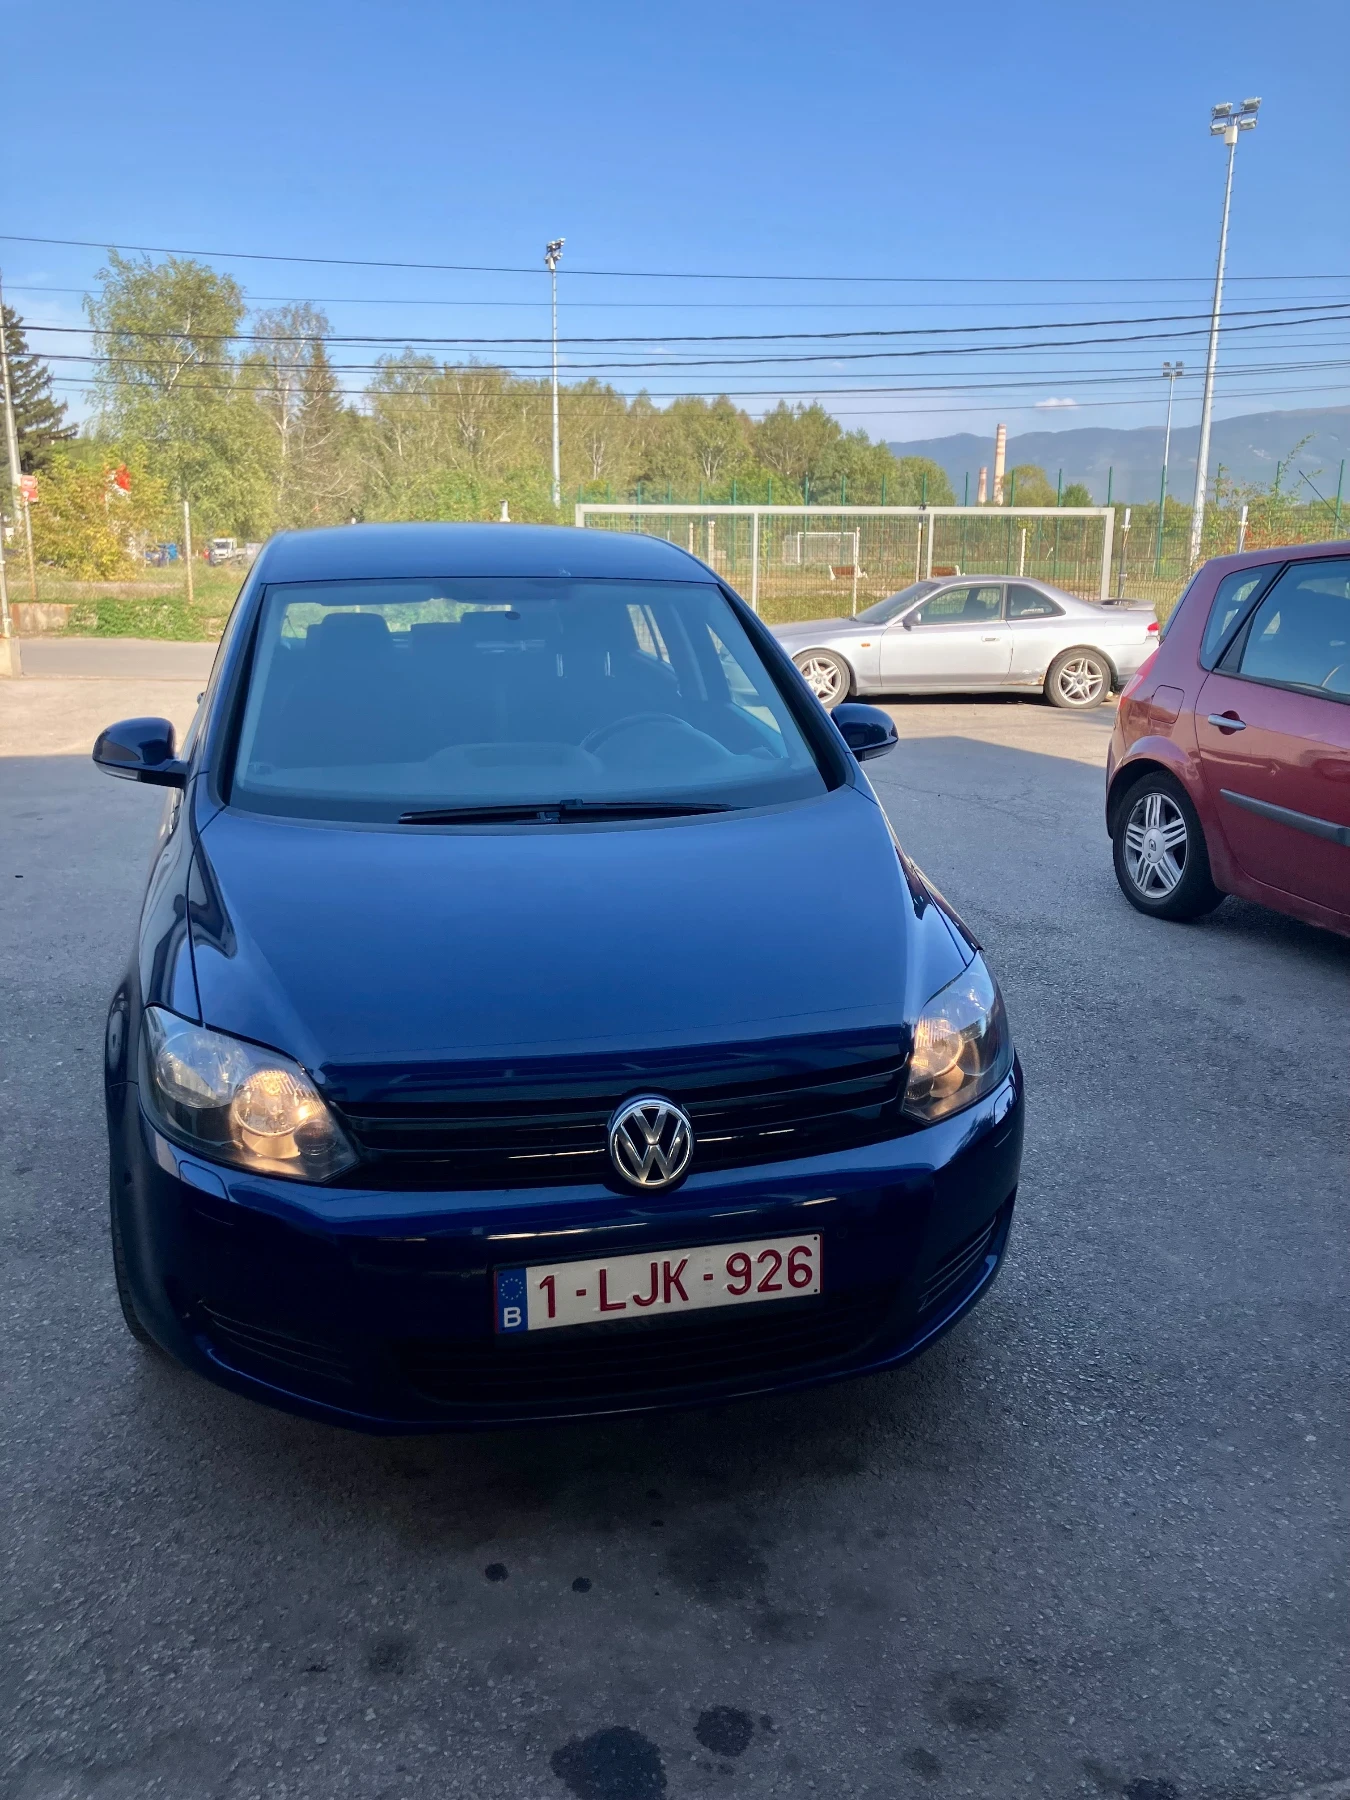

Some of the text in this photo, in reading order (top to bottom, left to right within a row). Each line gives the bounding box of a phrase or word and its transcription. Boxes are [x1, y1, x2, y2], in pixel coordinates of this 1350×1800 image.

[612, 1101, 690, 1186] VW
[503, 1306, 522, 1328] B
[539, 1245, 813, 1319] 1-LJK-926
